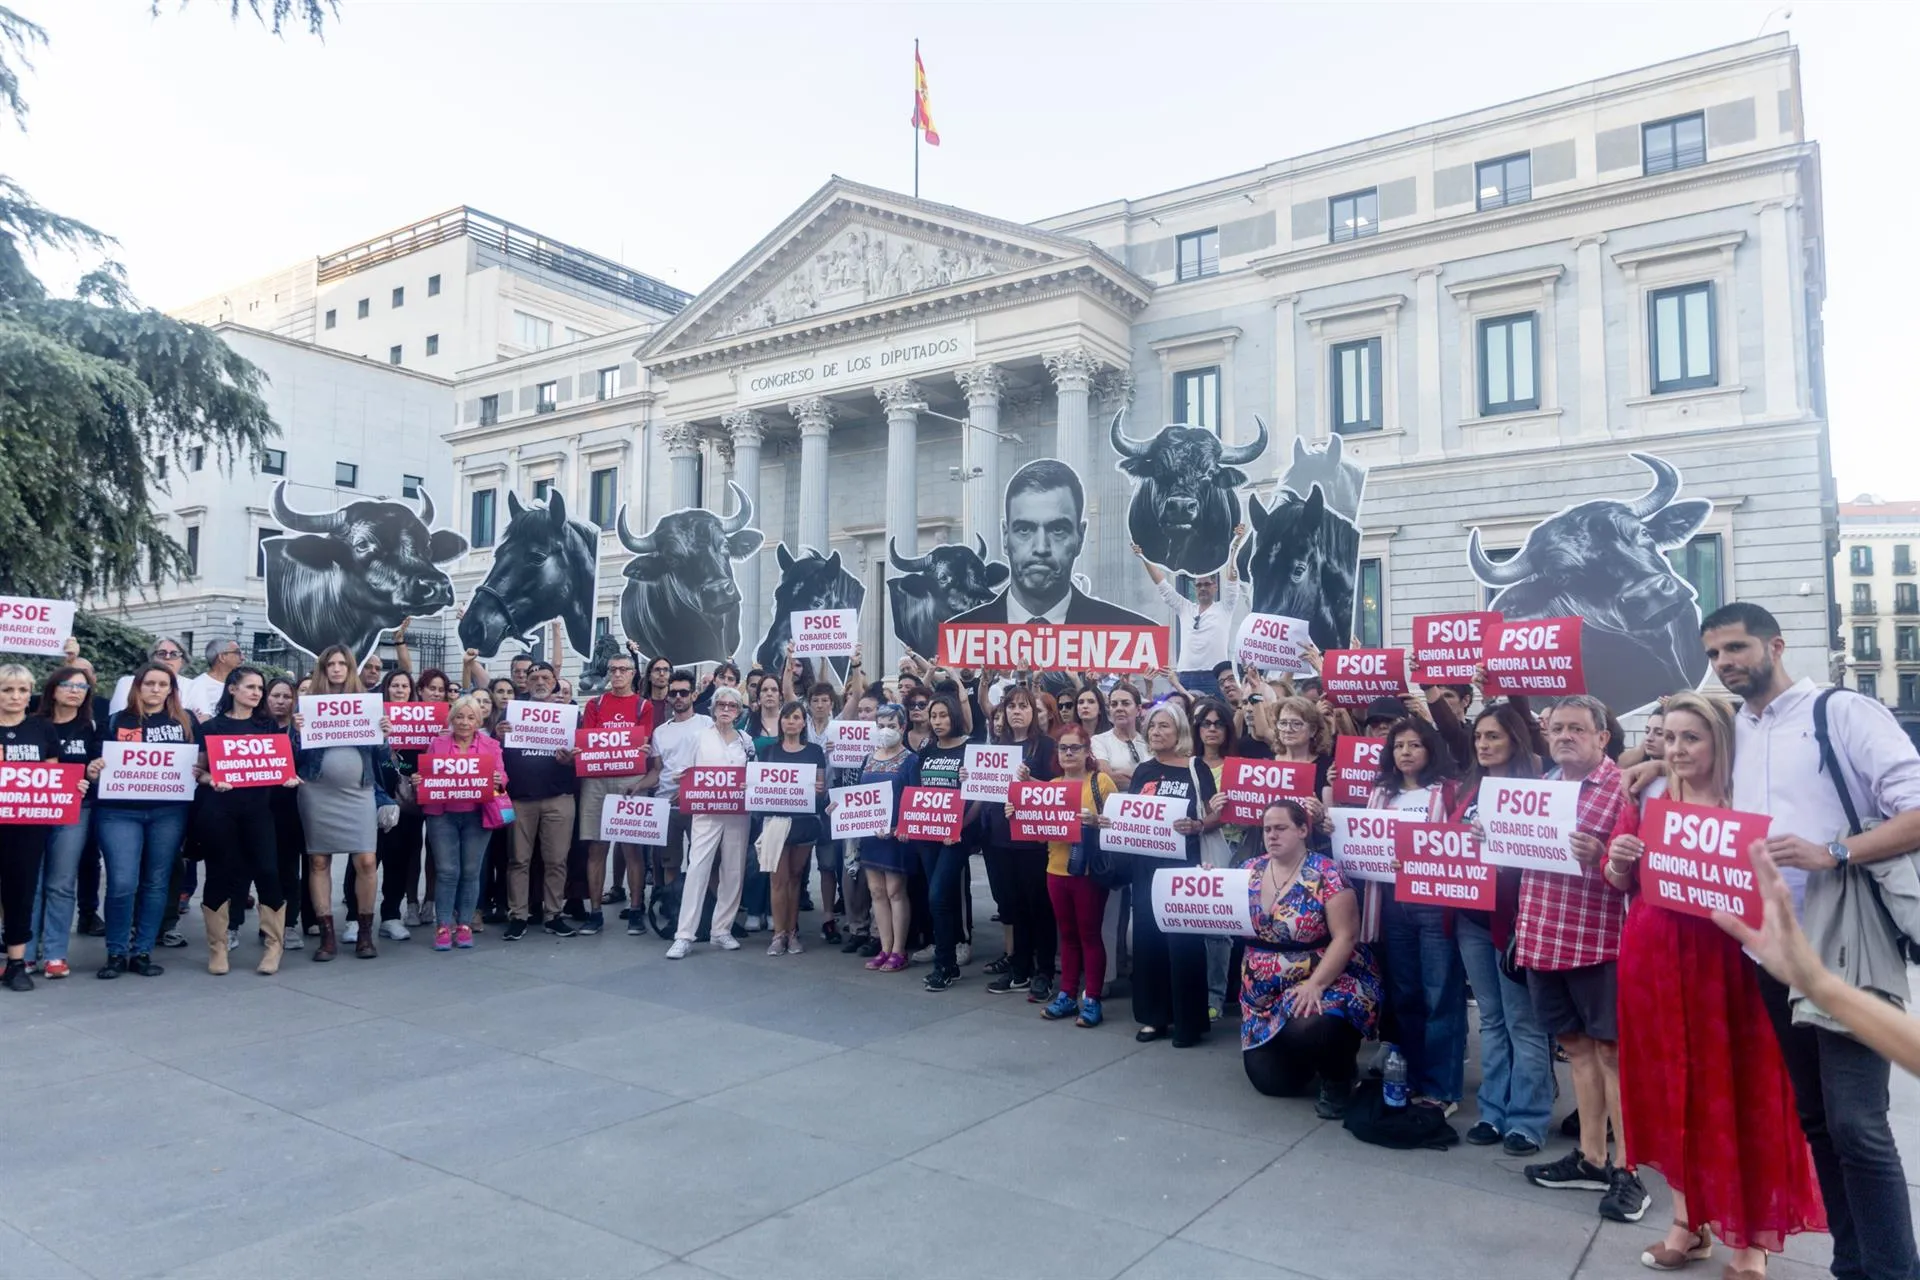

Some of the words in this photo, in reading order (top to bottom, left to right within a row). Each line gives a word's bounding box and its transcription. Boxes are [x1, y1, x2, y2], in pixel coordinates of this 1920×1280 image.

[751, 368, 814, 391] CONGRESO
[823, 363, 838, 377] DE
[847, 357, 871, 373] LOS
[881, 338, 958, 366] DIPUTADOS
[0, 604, 51, 621] PSOE
[804, 615, 841, 629] PSOE
[37, 627, 56, 635] CON
[1252, 619, 1289, 641] PSOE
[1428, 619, 1481, 643] PSOE
[3, 636, 60, 648] PODEROSOS
[1500, 625, 1560, 651] PSOE
[796, 644, 809, 652] LOS
[811, 642, 851, 651] PODEROSOS
[945, 627, 1159, 669] VERGÜENZA
[1243, 638, 1277, 652] COBARDE
[1279, 646, 1295, 655] CON
[1239, 649, 1252, 659] LOS
[1254, 653, 1301, 668] PODEROSOS
[1419, 648, 1455, 661] IGNORA
[1458, 648, 1470, 659] LA
[1337, 655, 1387, 675] PSOE
[1488, 658, 1529, 671] IGNORA
[1532, 657, 1546, 670] LA
[1548, 656, 1572, 669] VOZ
[1427, 666, 1443, 677] DEL
[1328, 680, 1363, 690] IGNORA
[1365, 680, 1377, 690] LA
[1380, 681, 1399, 690] VOZ
[1499, 677, 1520, 688] DEL
[1523, 676, 1566, 688] PUEBLO
[1337, 695, 1356, 703] DEL
[317, 700, 363, 716] PSOE
[390, 706, 435, 720] PSOE
[522, 708, 560, 723] PSOE
[312, 720, 351, 729] COBARDE
[515, 725, 548, 734] COBARDE
[551, 727, 565, 735] CON
[307, 732, 323, 741] LOS
[325, 730, 375, 740] PODEROSOS
[588, 731, 630, 747] PSOE
[840, 727, 870, 740] PSOE
[526, 736, 568, 745] PODEROSOS
[223, 739, 276, 756] PSOE
[122, 750, 175, 766] PSOE
[581, 751, 610, 761] IGNORA
[612, 750, 623, 758] LA
[625, 750, 639, 758] VOZ
[976, 752, 1008, 768] PSOE
[217, 759, 253, 770] IGNORA
[255, 759, 267, 767] LA
[269, 758, 287, 767] VOZ
[433, 758, 479, 774] PSOE
[587, 762, 602, 771] DEL
[604, 761, 634, 770] PUEBLO
[0, 767, 64, 788] PSOE
[113, 771, 158, 779] COBARDE
[161, 772, 181, 780] CON
[225, 773, 244, 782] DEL
[246, 770, 282, 781] PUEBLO
[694, 771, 736, 786] PSOE
[761, 769, 799, 783] PSOE
[971, 772, 998, 781] COBARDE
[1000, 773, 1013, 781] CON
[1238, 764, 1295, 790] PSOE
[106, 783, 124, 791] LOS
[128, 784, 184, 792] PODEROSOS
[425, 779, 456, 787] IGNORA
[458, 778, 469, 787] LA
[472, 778, 488, 786] VOZ
[967, 784, 979, 792] LOS
[430, 791, 446, 799] DEL
[449, 790, 481, 798] PUEBLO
[729, 791, 744, 799] VOZ
[755, 787, 788, 795] COBARDE
[1021, 787, 1067, 805] PSOE
[1227, 790, 1265, 804] IGNORA
[1349, 785, 1369, 797] DEL
[33, 793, 48, 803] LA
[51, 793, 73, 804] VOZ
[766, 798, 808, 806] PODEROSOS
[845, 790, 880, 807] PSOE
[913, 792, 953, 808] PSOE
[1497, 789, 1552, 817] PSOE
[18, 807, 63, 818] PUEBLO
[617, 801, 654, 816] PSOE
[840, 809, 871, 820] COBARDE
[874, 808, 886, 816] CON
[1120, 800, 1166, 821] PSOE
[1236, 806, 1254, 819] DEL
[904, 812, 930, 822] IGNORA
[932, 813, 941, 822] LA
[943, 814, 957, 823] VOZ
[1016, 811, 1042, 820] IGNORA
[1045, 811, 1055, 820] LA
[1058, 811, 1075, 821] VOZ
[610, 818, 641, 826] COBARDE
[643, 820, 657, 828] CON
[836, 823, 849, 832] LOS
[1112, 822, 1151, 834] COBARDE
[1153, 827, 1171, 837] CON
[1490, 820, 1536, 837] COBARDE
[1537, 826, 1558, 839] CON
[620, 829, 660, 839] PODEROSOS
[908, 825, 920, 834] DEL
[922, 825, 950, 836] PUEBLO
[1022, 825, 1037, 834] DEL
[1038, 825, 1067, 836] PUEBLO
[1664, 811, 1741, 858] PSOE
[1106, 835, 1121, 845] LOS
[1125, 838, 1176, 851] PODEROSOS
[1413, 830, 1475, 858] PSOE
[1344, 844, 1385, 856] COBARDE
[1488, 840, 1504, 853] LOS
[1507, 842, 1567, 861] PODEROSOS
[1404, 861, 1445, 877] IGNORA
[1449, 865, 1463, 879] LA
[1466, 865, 1488, 880] VOZ
[1649, 851, 1699, 880] IGNORA
[1702, 862, 1720, 884] LA
[1723, 866, 1752, 891] VOZ
[1172, 876, 1224, 897] PSOE
[1412, 881, 1432, 896] DEL
[1435, 883, 1478, 900] PUEBLO
[1659, 880, 1686, 902] DEL
[1688, 886, 1744, 916] PUEBLO
[1165, 902, 1210, 914] COBARDE
[1213, 904, 1233, 915] CON
[1163, 918, 1181, 927] LOS
[1184, 919, 1243, 930] PODEROSOS
